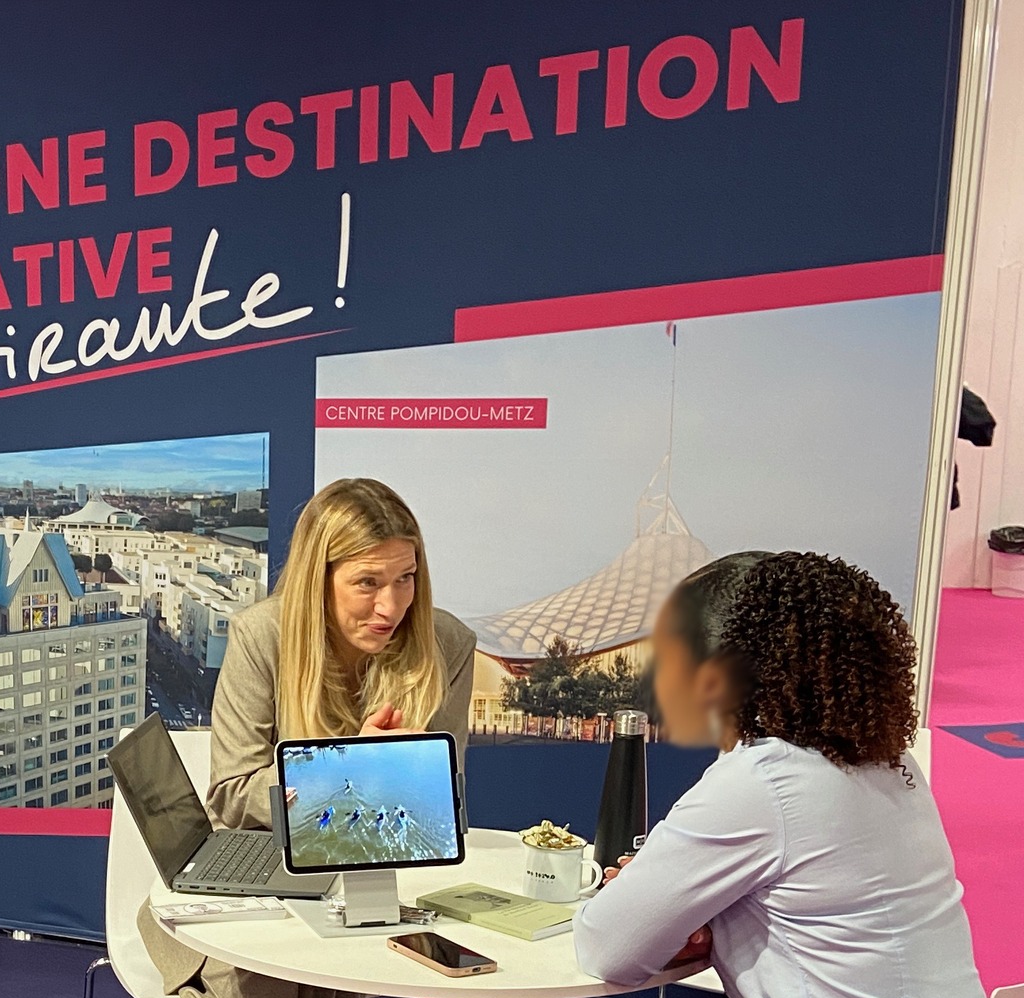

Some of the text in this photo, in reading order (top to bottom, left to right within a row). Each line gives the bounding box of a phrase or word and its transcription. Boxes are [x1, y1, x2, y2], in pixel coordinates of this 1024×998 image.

[134, 18, 805, 197] DESTINATION
[326, 406, 534, 421] CENTRE POMPIDOU-METZ
